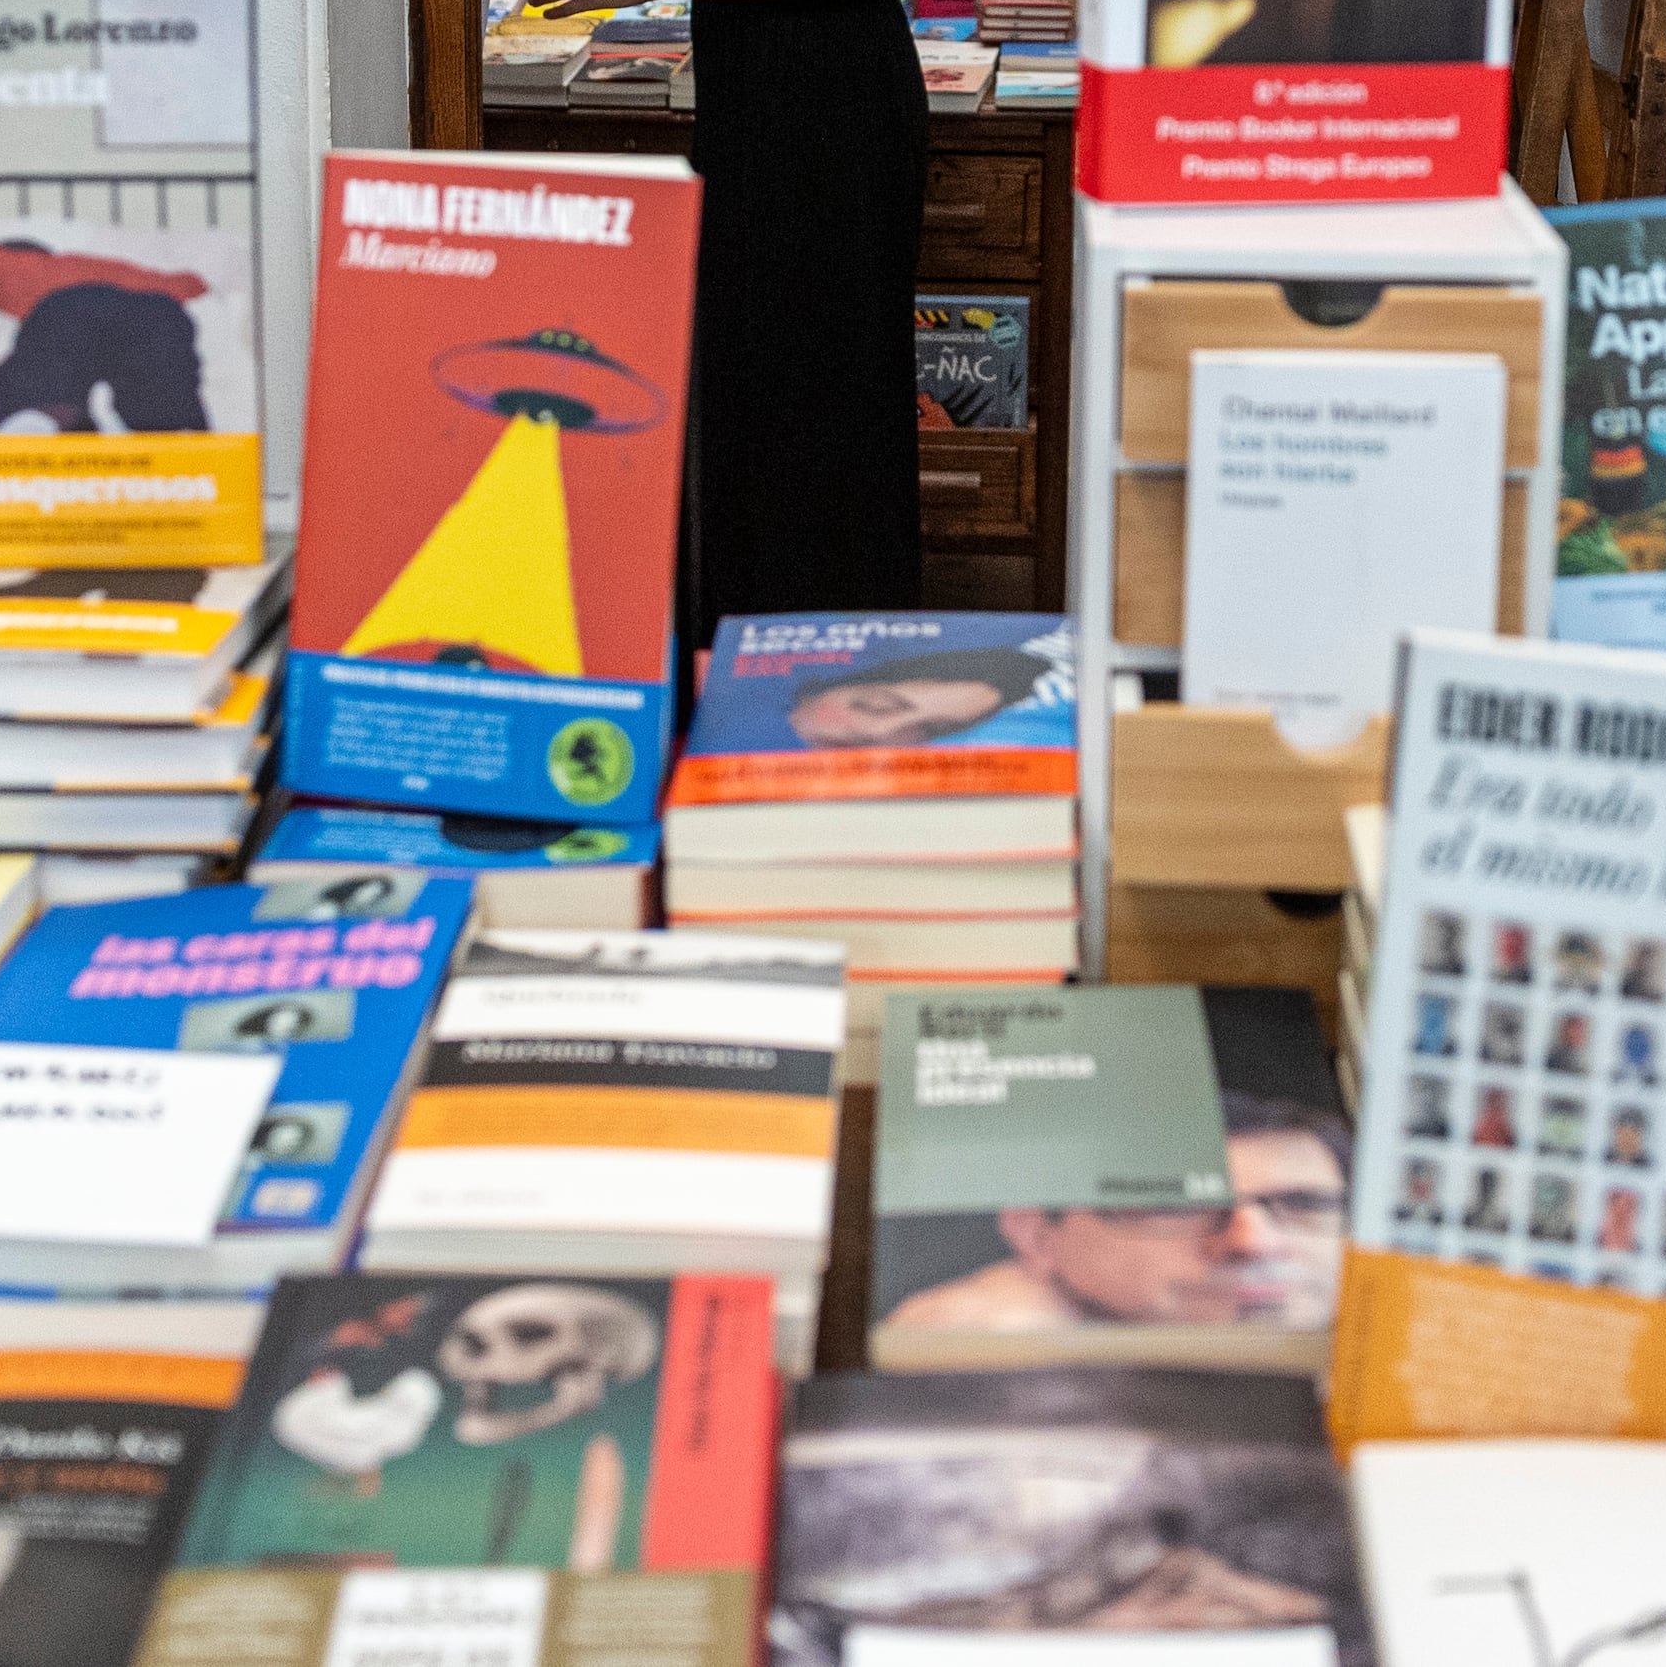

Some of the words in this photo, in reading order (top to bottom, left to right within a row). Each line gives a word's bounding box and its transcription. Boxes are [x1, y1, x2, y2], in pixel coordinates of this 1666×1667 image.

[43, 12, 197, 47] Lorenzo
[342, 179, 438, 229] NONA
[445, 185, 635, 246] FERNÁNDEZ
[341, 232, 496, 279] Marciano
[1436, 682, 1559, 752] EIDER
[1422, 821, 1474, 874] el
[1480, 838, 1650, 898] mismo
[71, 955, 422, 1003] monstruo
